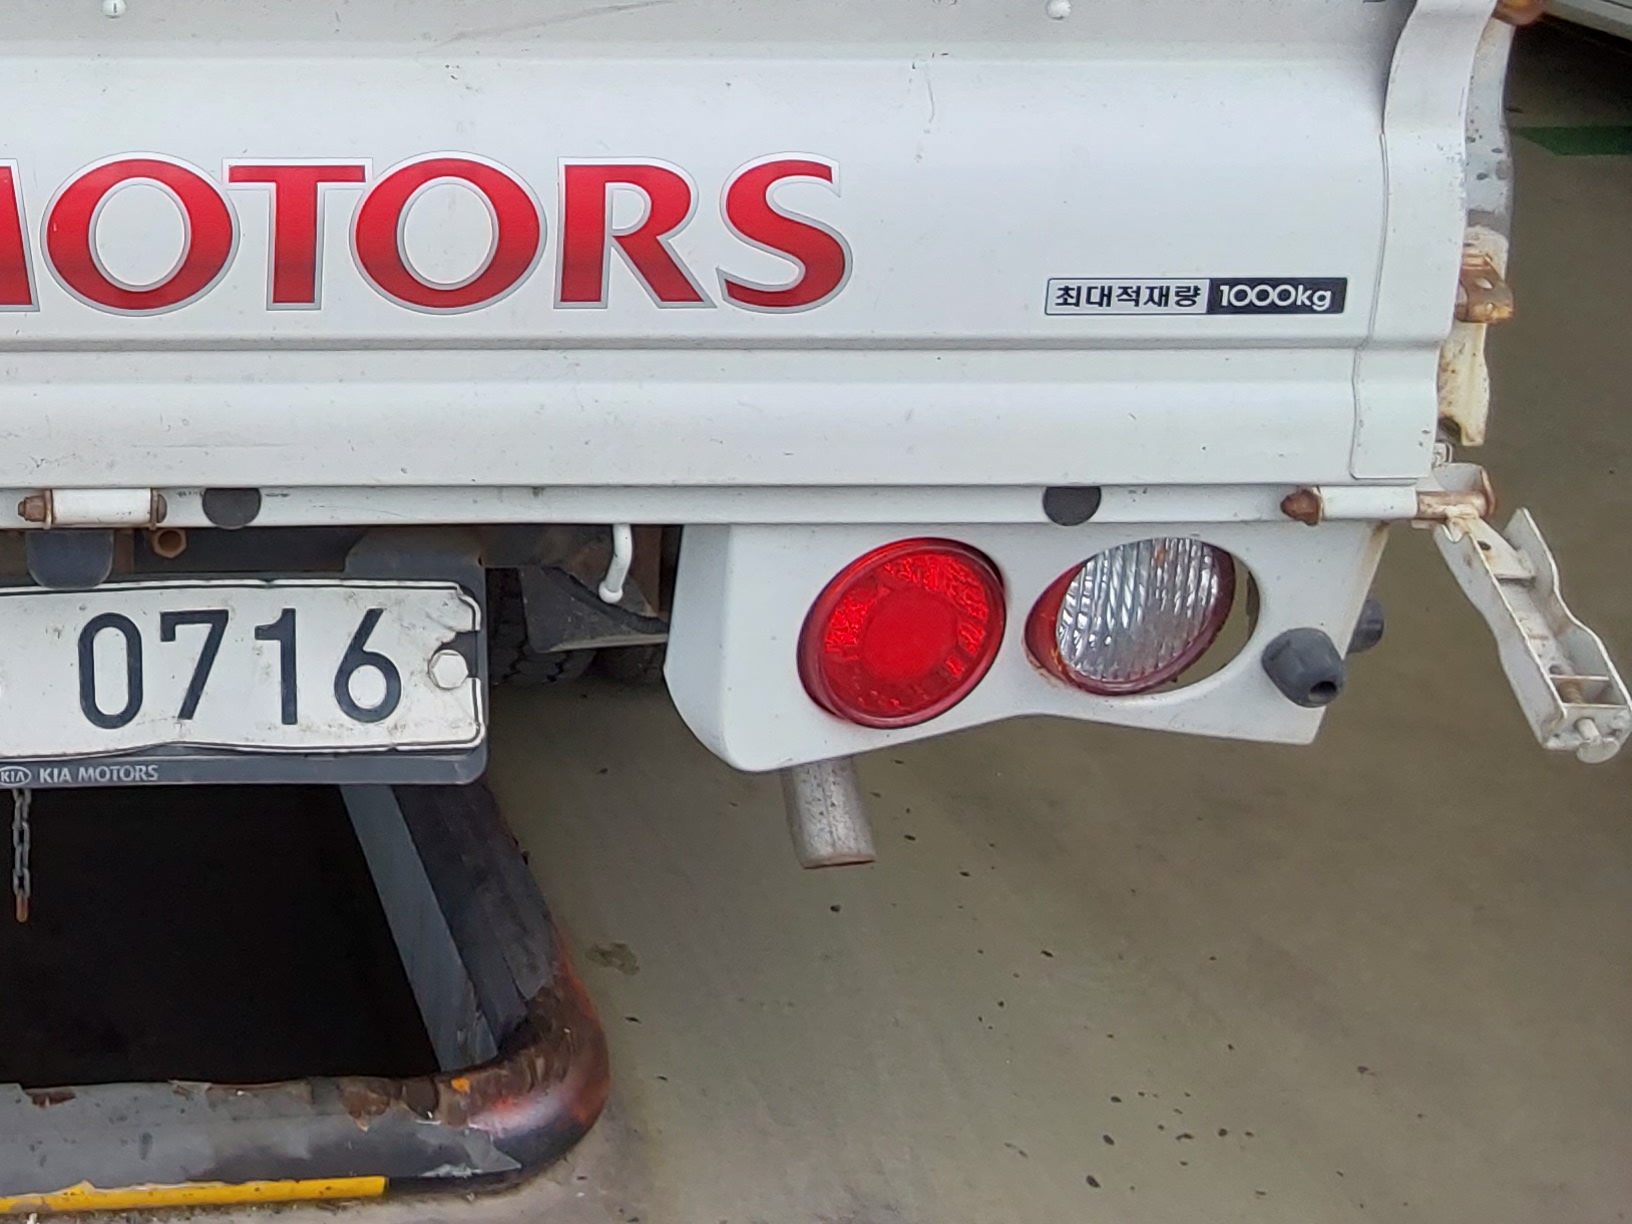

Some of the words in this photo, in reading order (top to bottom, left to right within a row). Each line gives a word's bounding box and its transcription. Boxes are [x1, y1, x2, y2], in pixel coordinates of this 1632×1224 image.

[1055, 285, 1202, 308] 최대적재량
[1219, 284, 1332, 311] 1000kg
[76, 607, 404, 730] 0716
[38, 767, 72, 784] KIA
[77, 764, 159, 783] MOTORS
